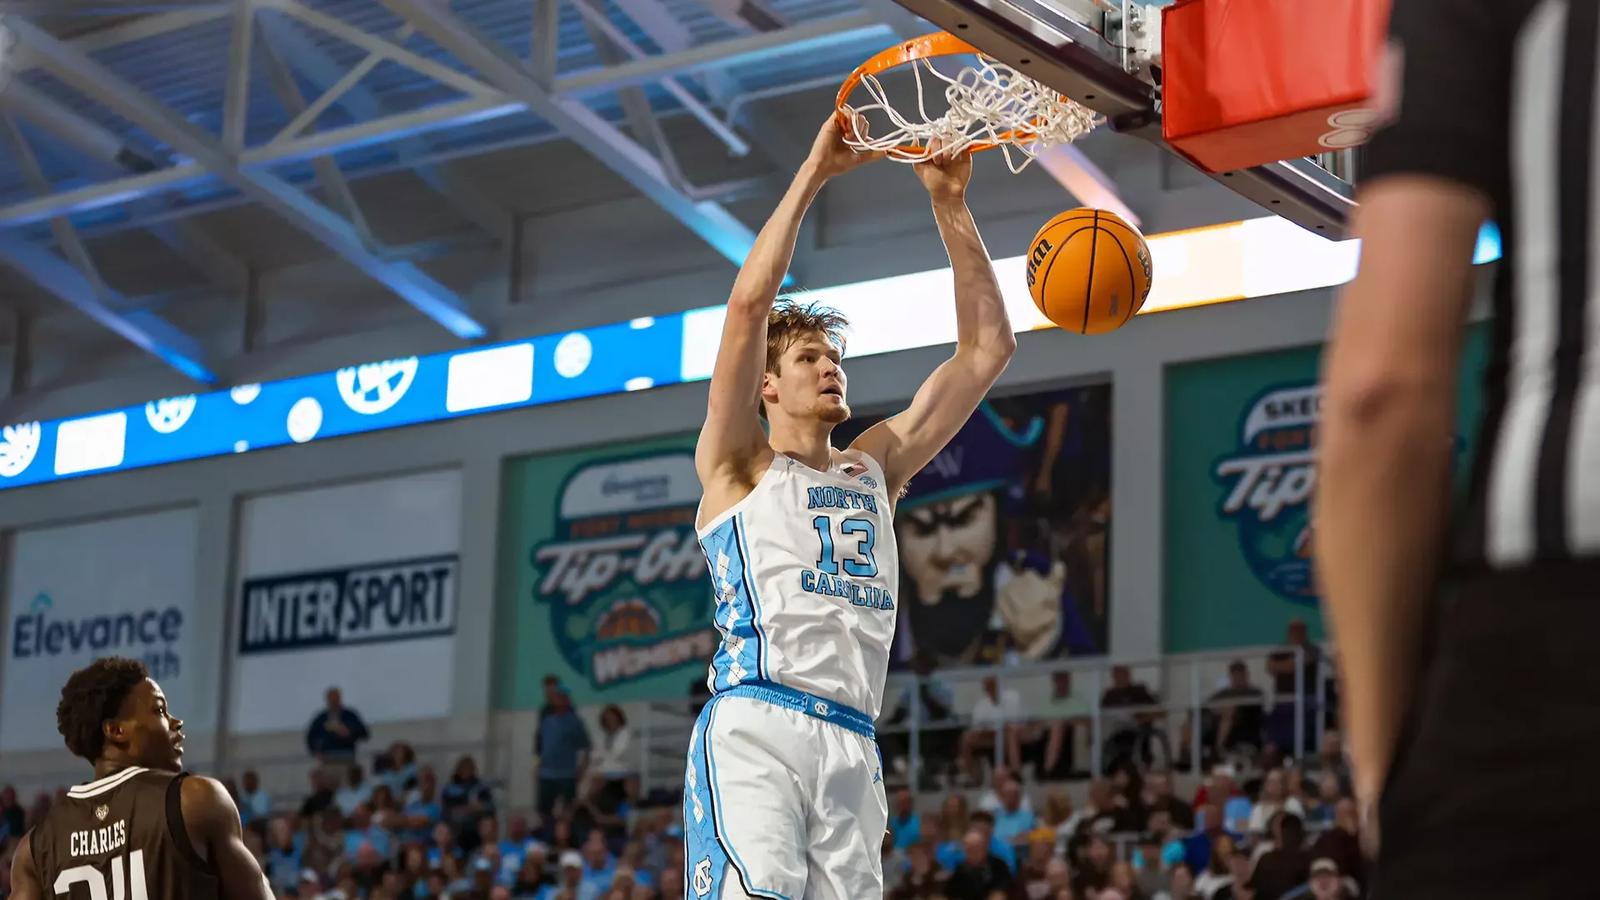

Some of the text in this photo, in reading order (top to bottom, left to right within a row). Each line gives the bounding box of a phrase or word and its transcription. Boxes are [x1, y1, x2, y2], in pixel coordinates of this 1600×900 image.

[808, 486, 878, 514] NORTH
[813, 515, 879, 578] 13
[801, 569, 896, 611] CARLINA
[13, 606, 183, 658] Elevance
[70, 819, 126, 857] CHARLES
